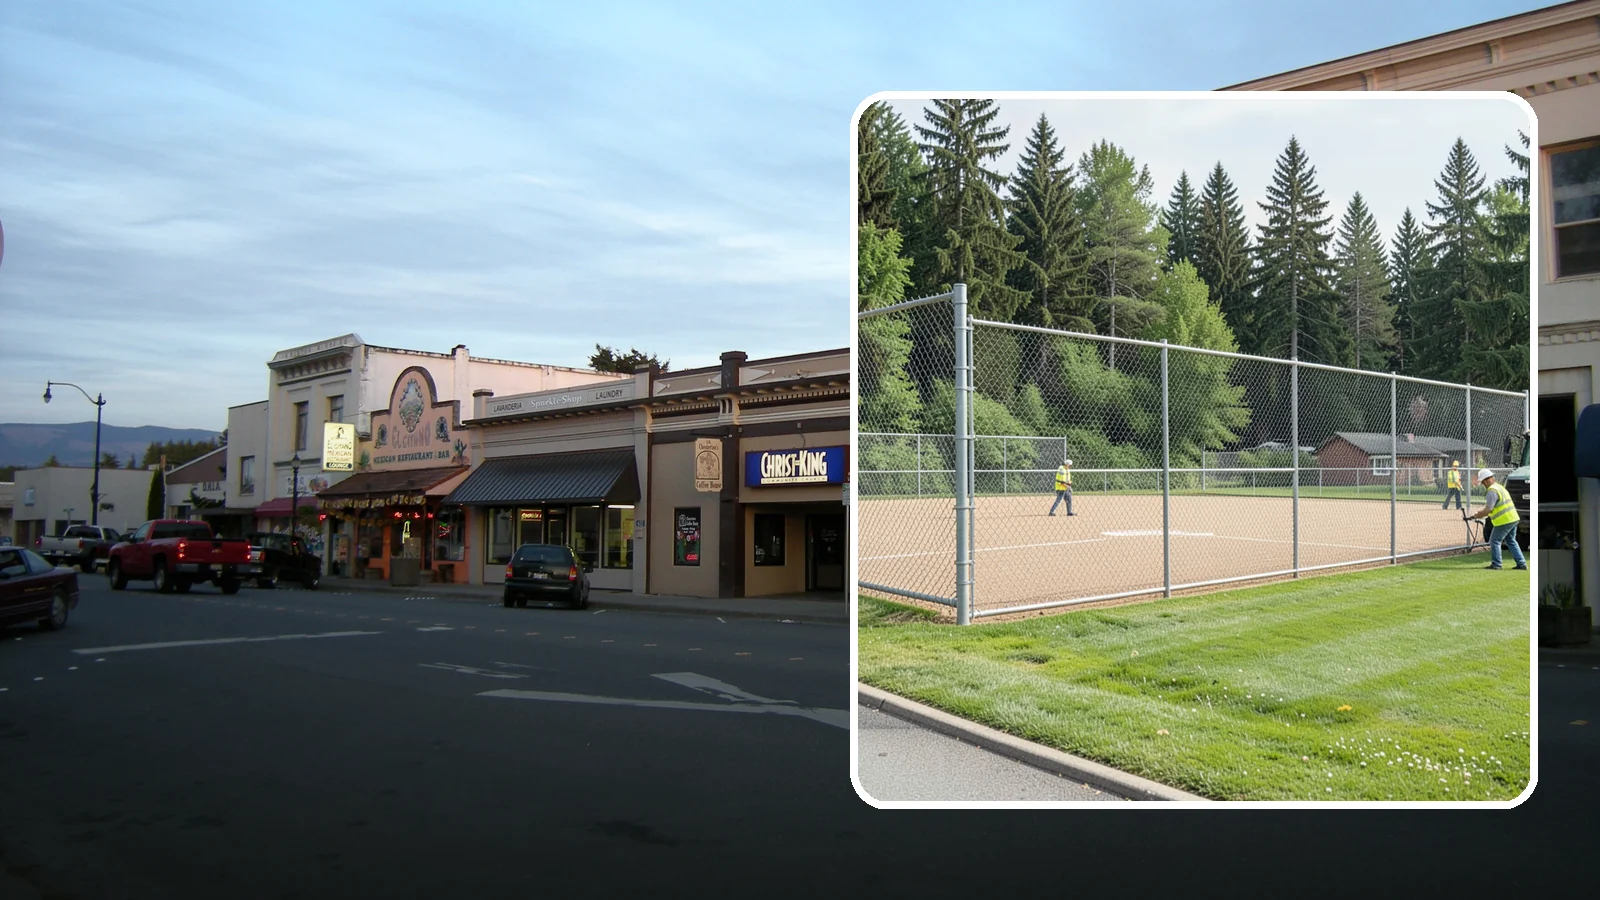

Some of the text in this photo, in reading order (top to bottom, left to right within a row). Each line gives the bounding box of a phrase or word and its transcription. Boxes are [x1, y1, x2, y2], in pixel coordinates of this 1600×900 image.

[531, 394, 583, 409] Sparkle Shop
[595, 389, 623, 400] LAUNDRY
[493, 402, 523, 413] LAVANDERIA
[373, 455, 396, 464] MEXICAN
[397, 451, 434, 462] RESTAURANT
[438, 450, 450, 459] BAR
[760, 450, 827, 478] CHRIST KING
